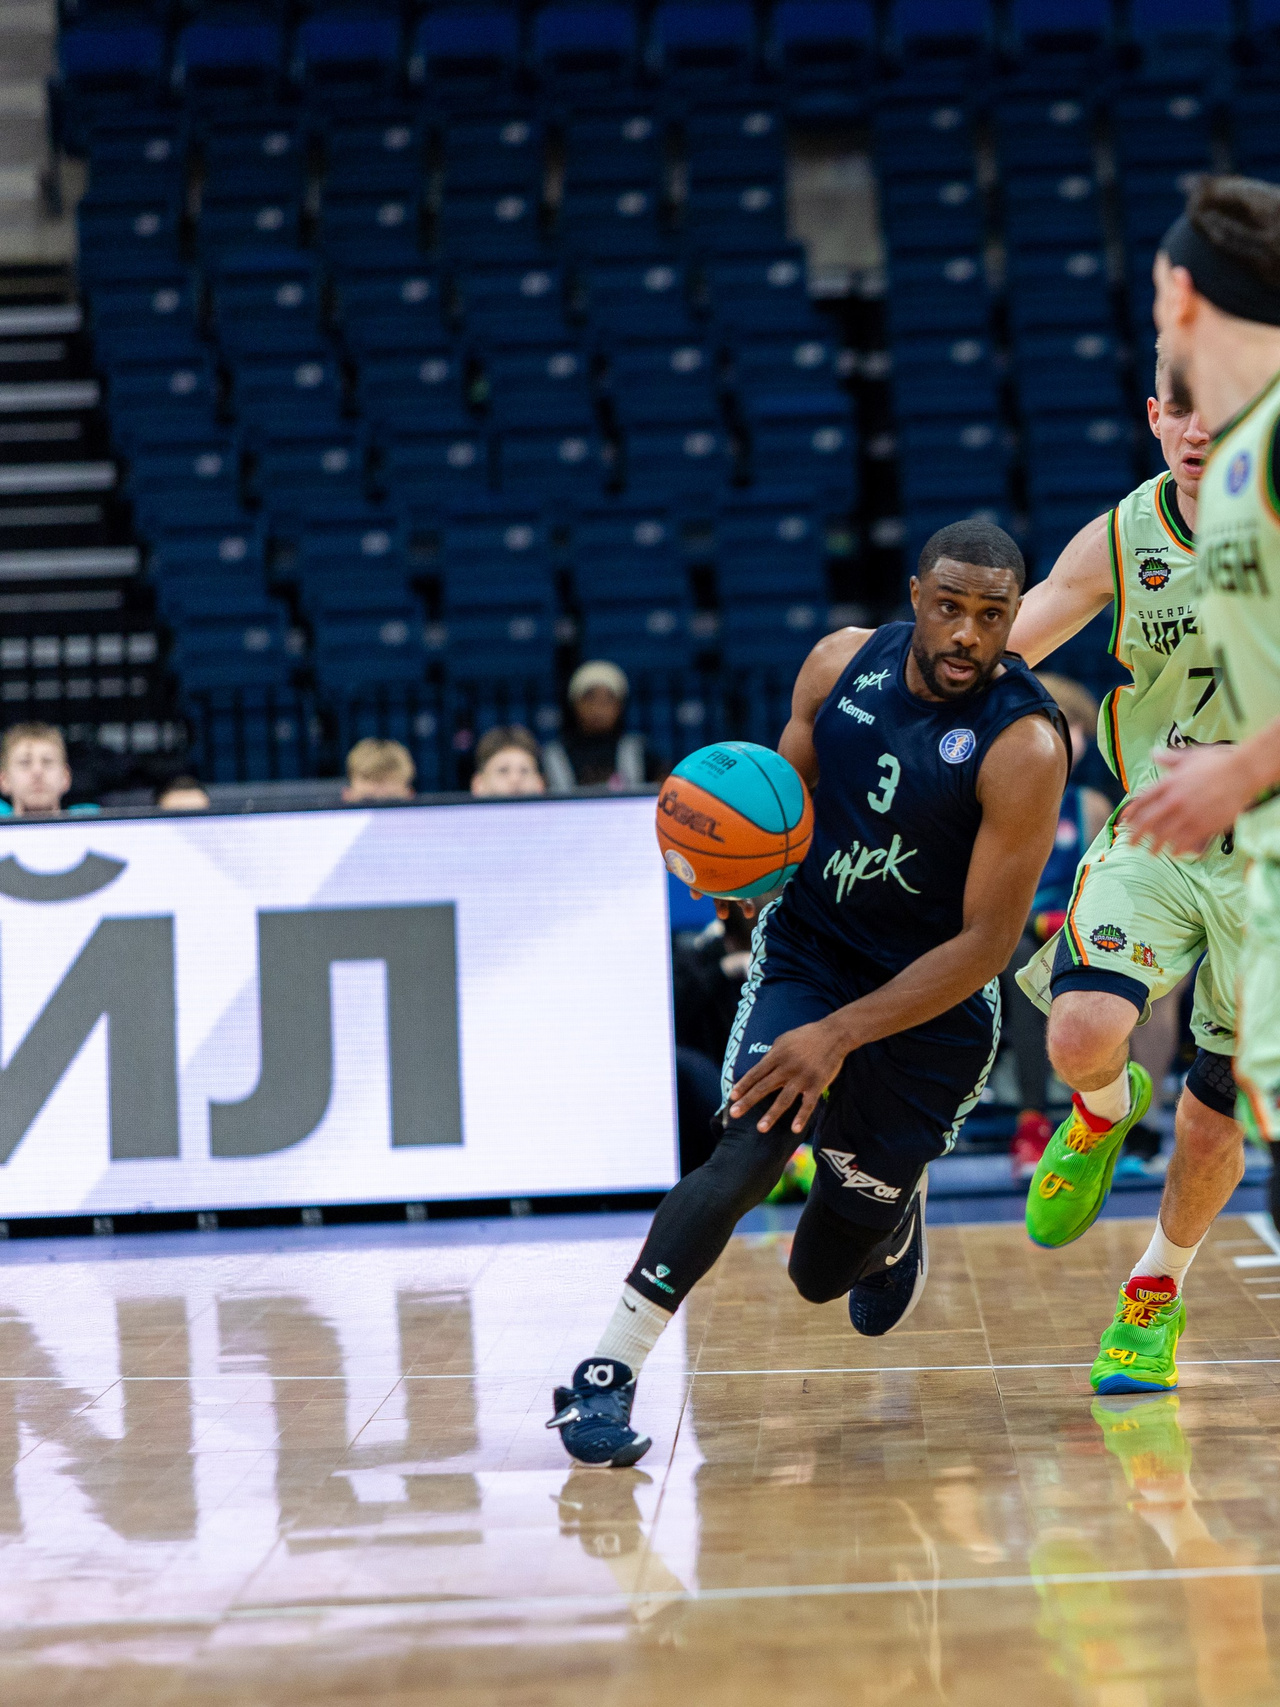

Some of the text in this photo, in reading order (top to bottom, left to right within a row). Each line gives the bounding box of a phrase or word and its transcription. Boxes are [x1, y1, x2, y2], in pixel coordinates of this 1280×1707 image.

[1138, 605, 1193, 619] SVERDL
[1187, 666, 1223, 717] 7
[837, 696, 876, 726] Kempa
[706, 750, 738, 771] FIBA
[867, 753, 901, 814] 3
